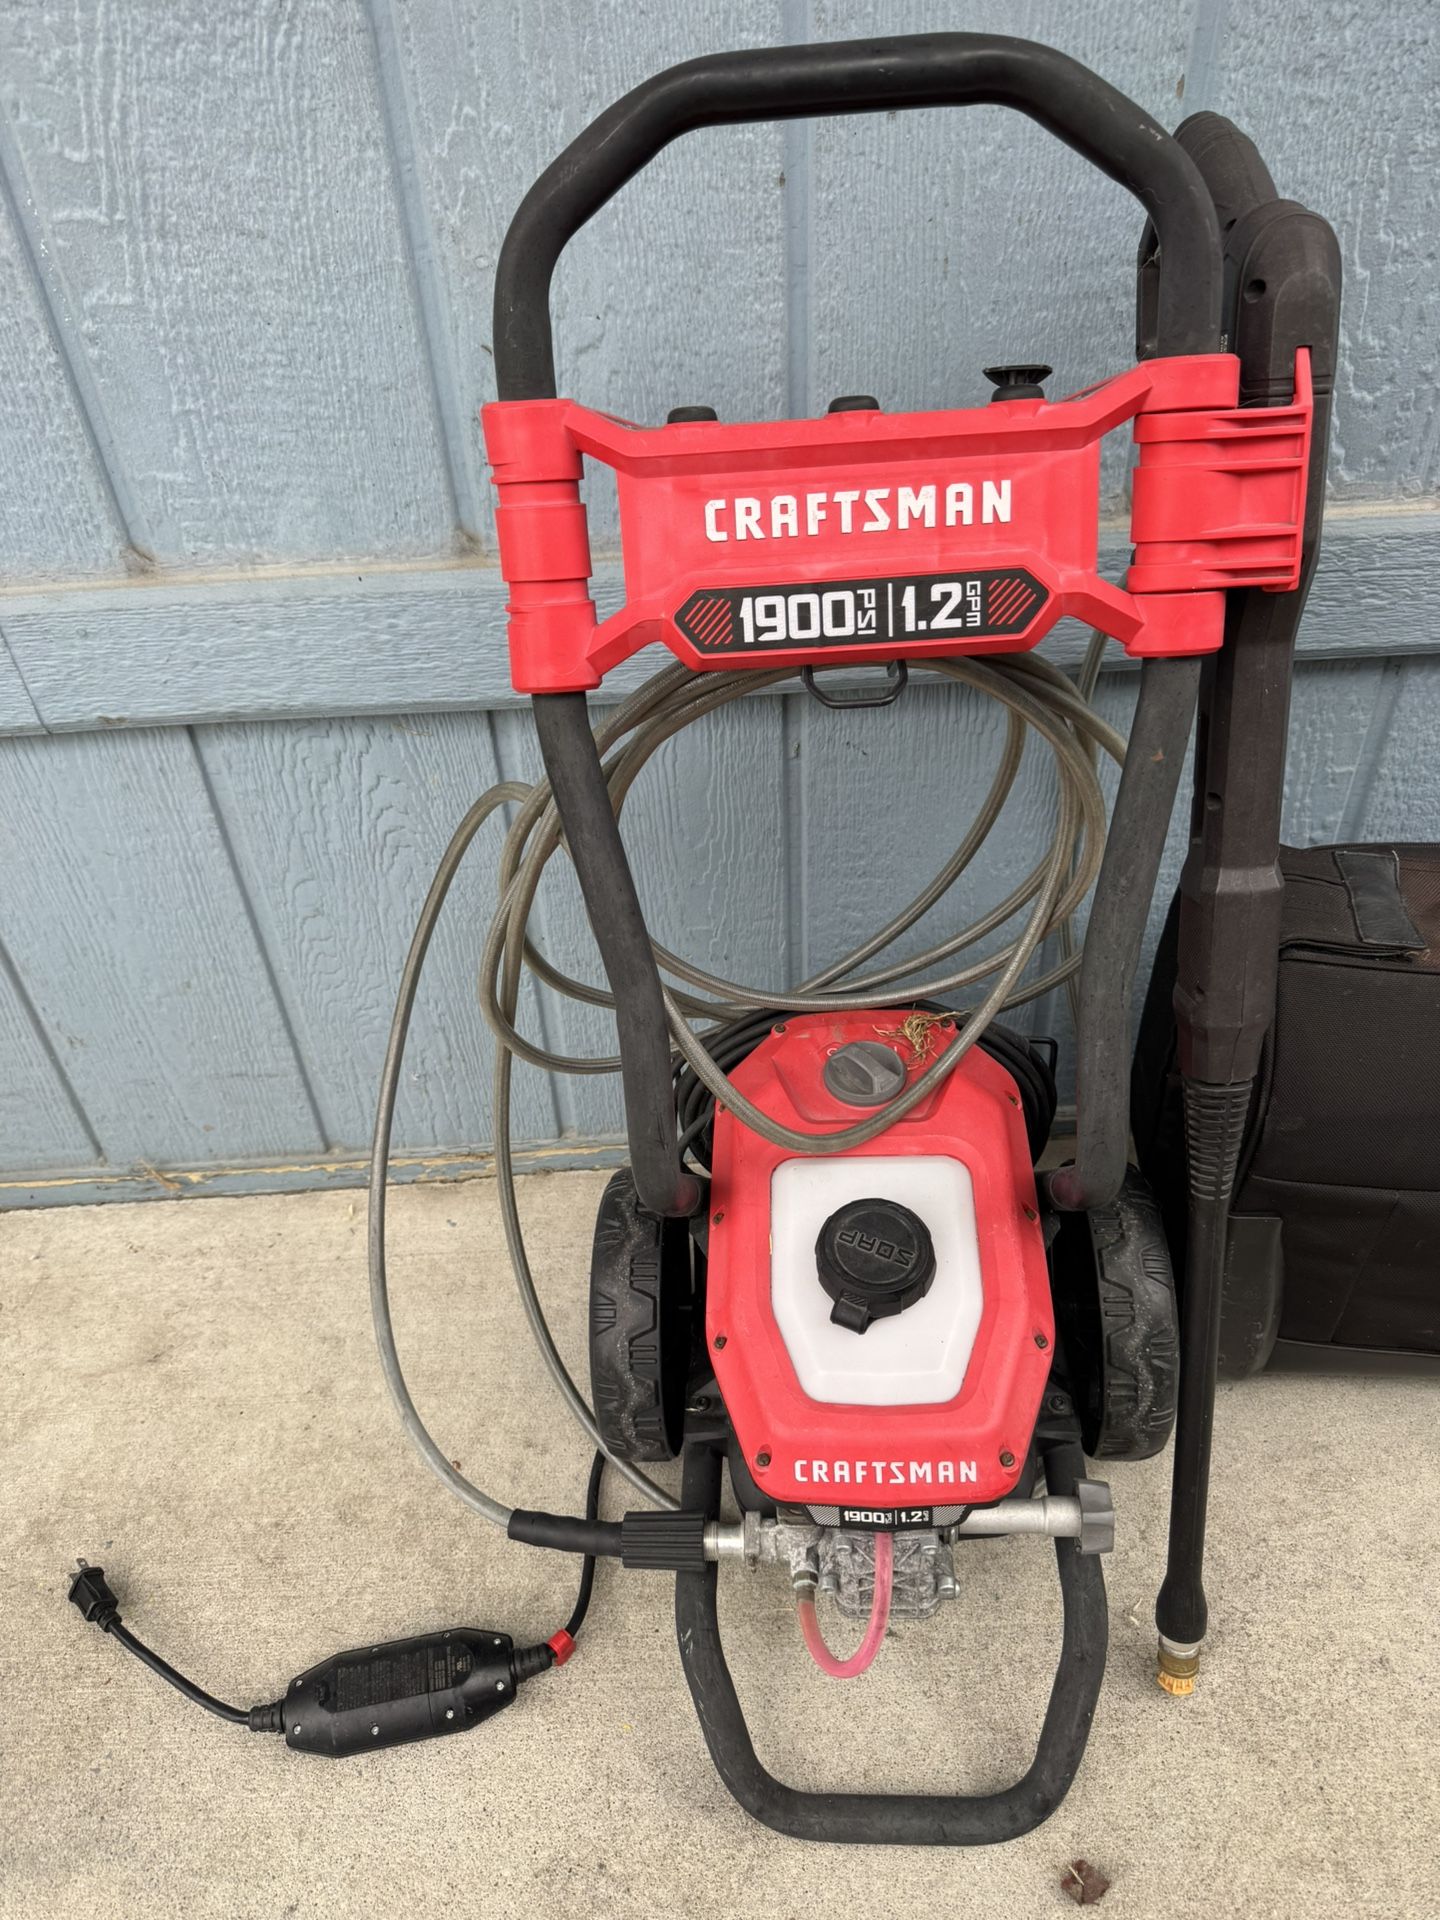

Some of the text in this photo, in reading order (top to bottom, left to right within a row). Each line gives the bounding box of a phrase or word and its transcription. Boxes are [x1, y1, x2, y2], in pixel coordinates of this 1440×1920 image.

[704, 479, 1012, 543] CRAFTSMAN
[738, 580, 982, 644] 1900 PSI 1.2 GPM
[837, 1230, 915, 1268] SOAP
[793, 1459, 978, 1484] CRAFTSMAN
[843, 1510, 885, 1524] 1900
[900, 1510, 923, 1523] 1.2
